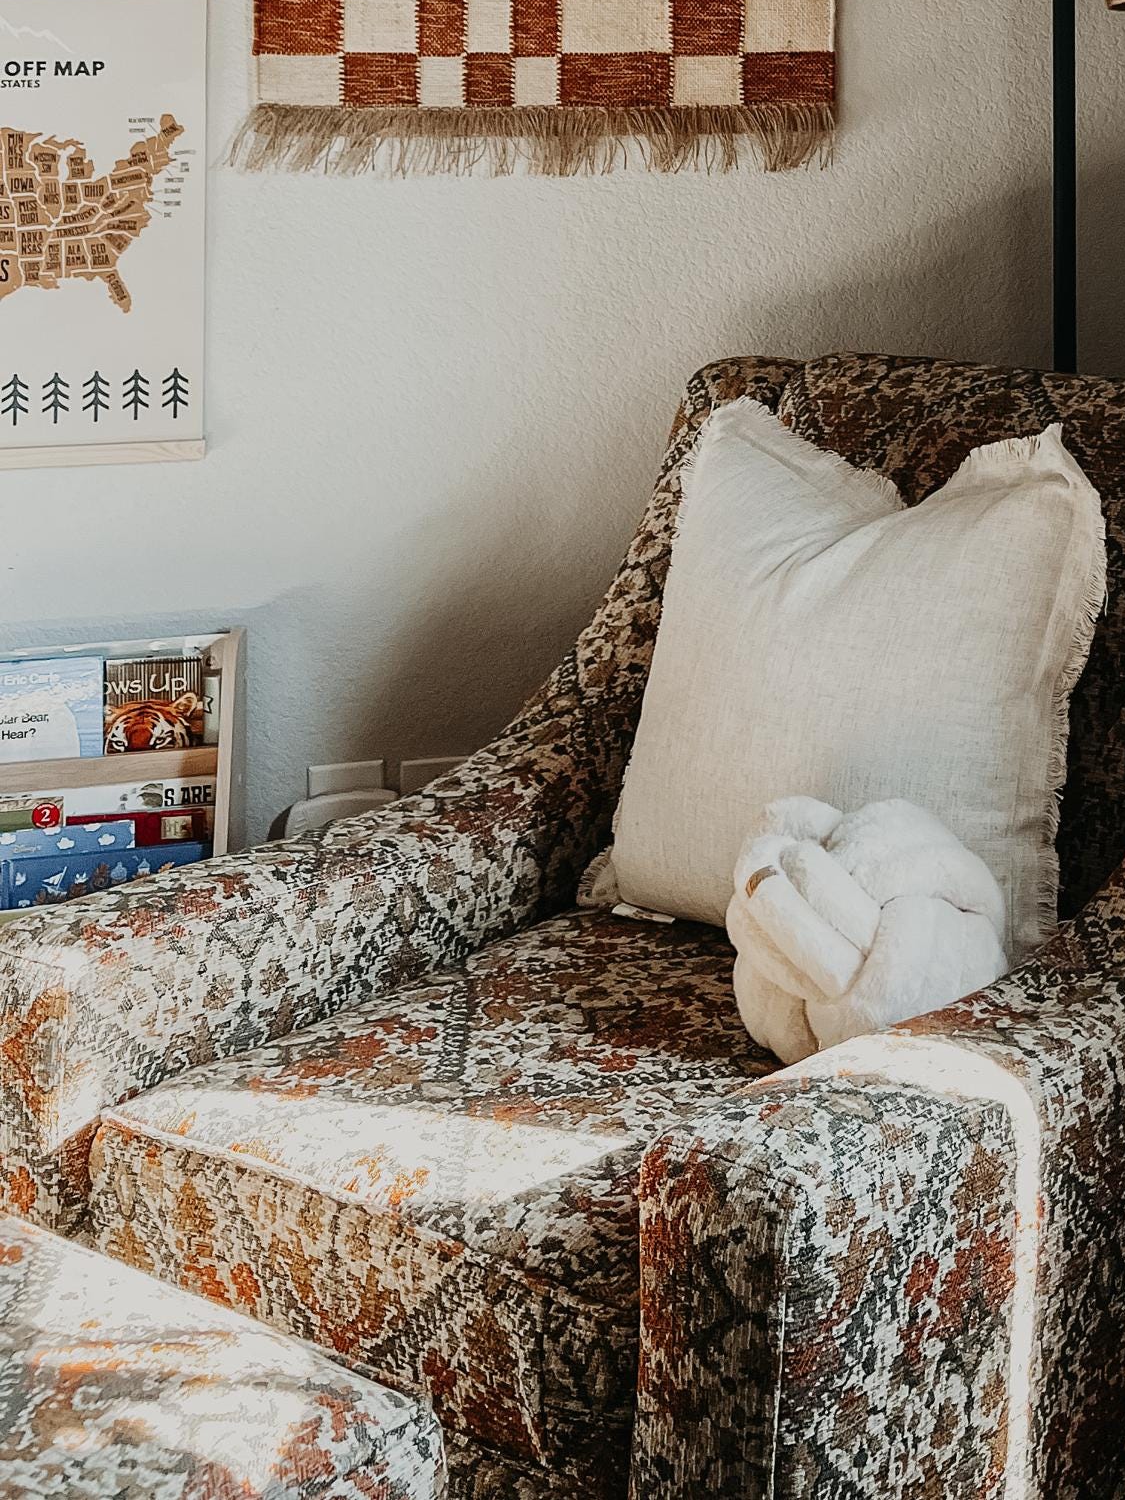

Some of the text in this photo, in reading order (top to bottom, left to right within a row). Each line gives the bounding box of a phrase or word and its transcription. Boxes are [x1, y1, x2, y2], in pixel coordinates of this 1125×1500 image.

[5, 61, 105, 76] OFF MAP
[0, 79, 40, 88] STATES
[10, 177, 34, 192] IOWA
[84, 184, 104, 198] OHIO
[63, 207, 97, 224] KENTUCKY
[149, 672, 187, 701] Up
[21, 713, 49, 723] Bear,
[1, 727, 36, 739] Hear?
[40, 809, 51, 822] 2
